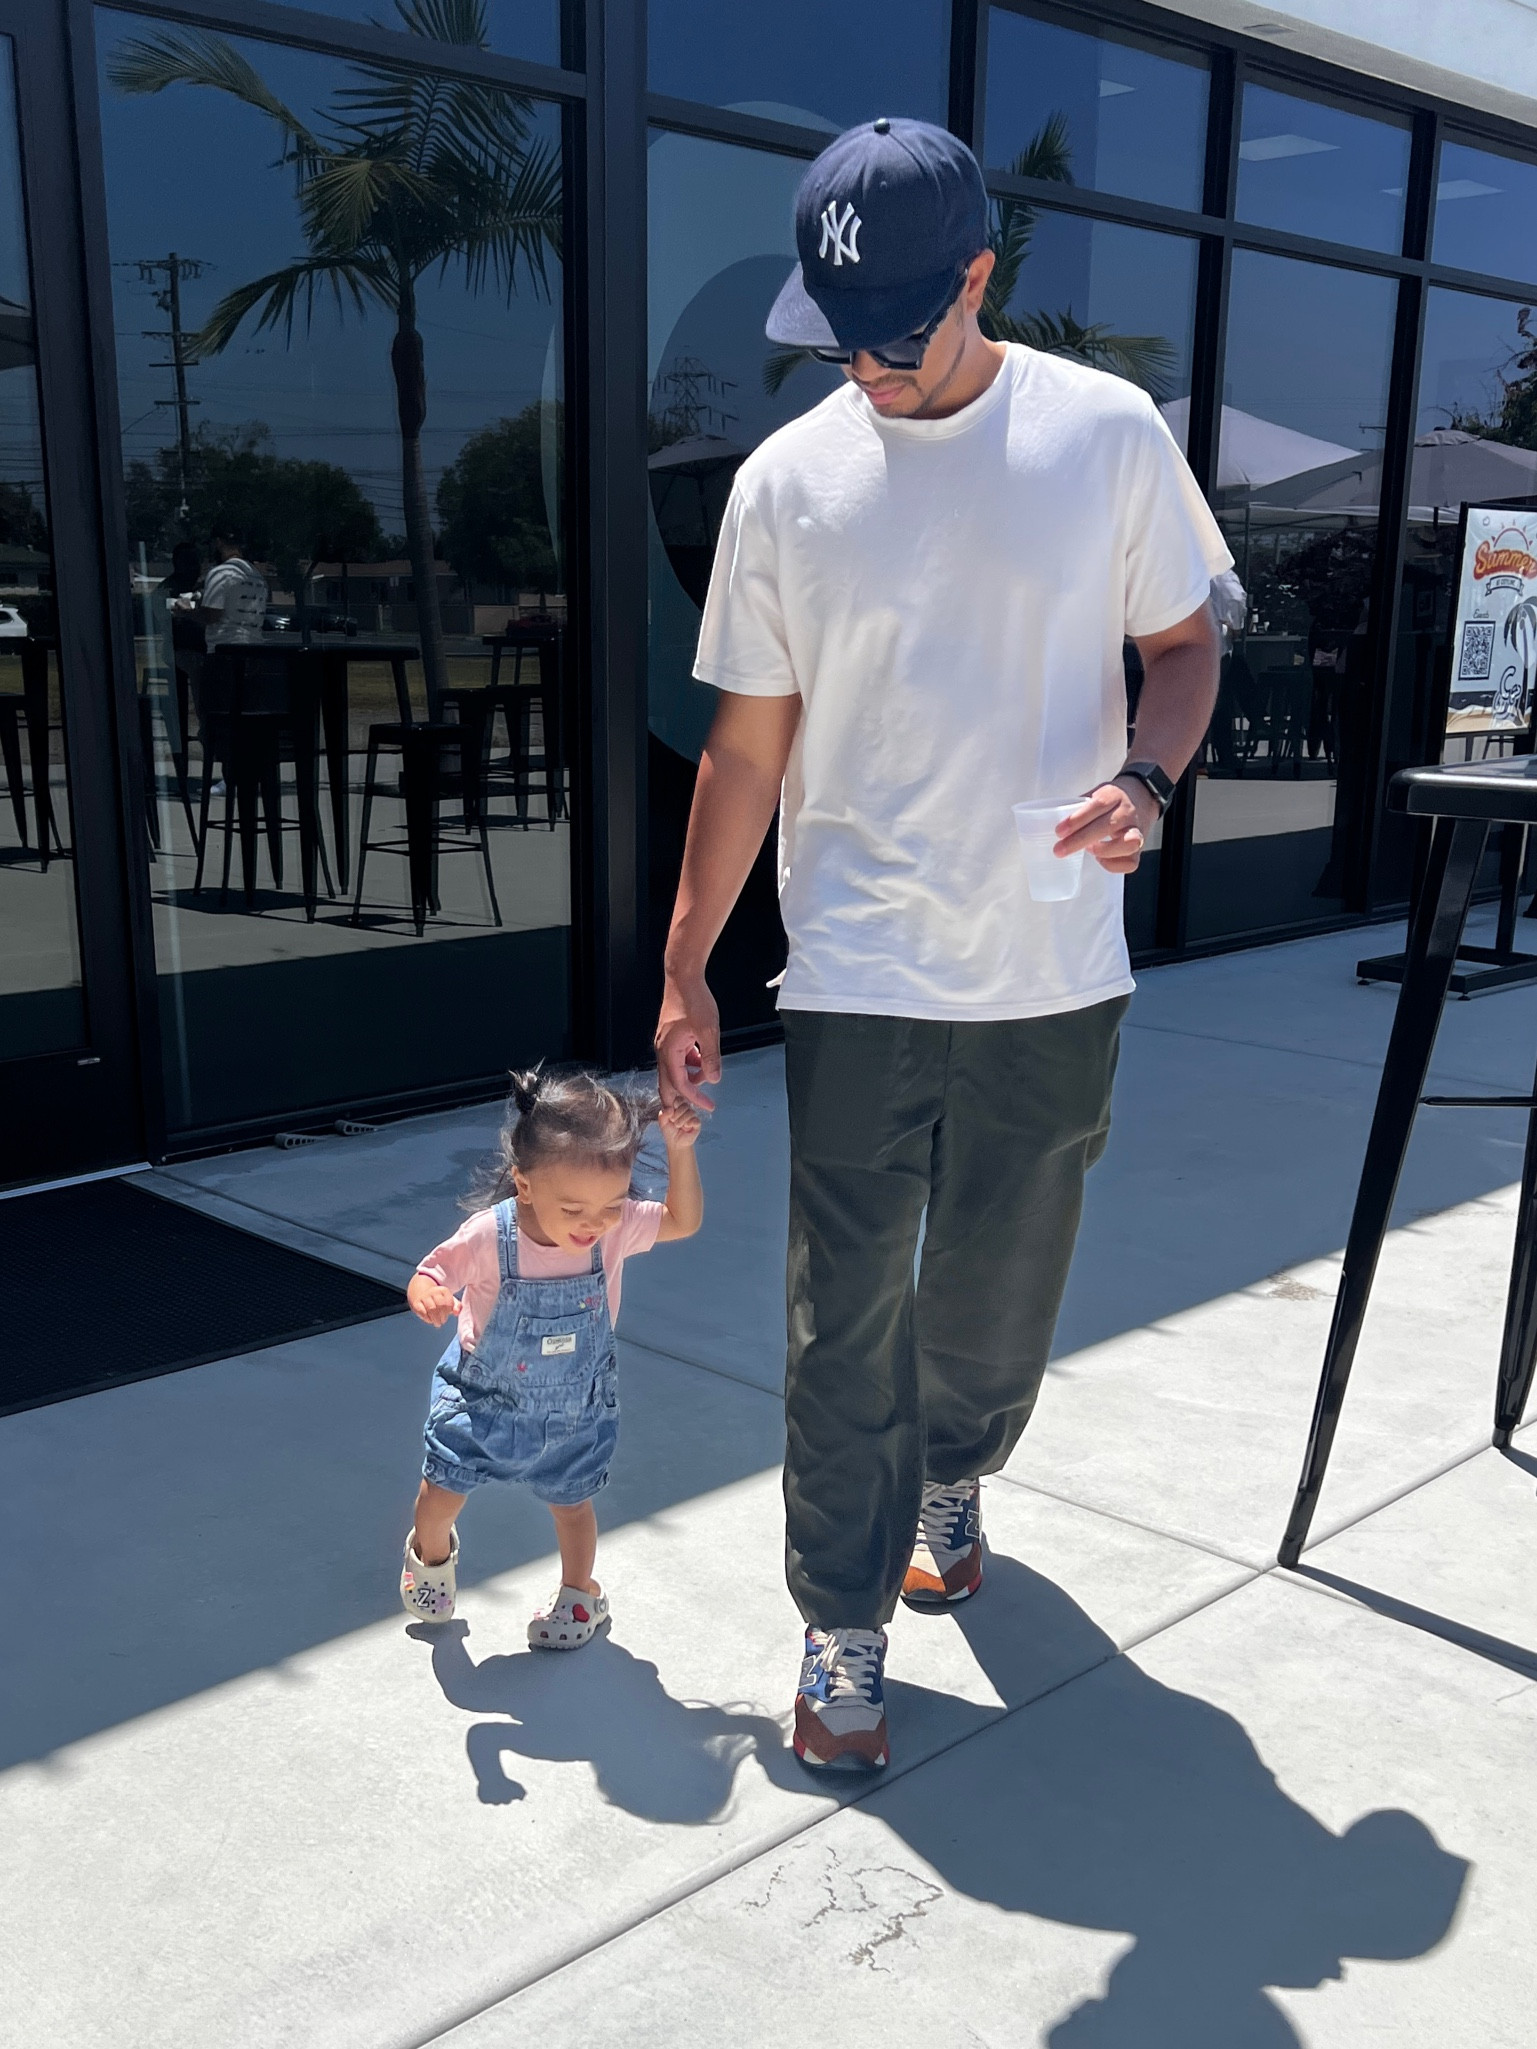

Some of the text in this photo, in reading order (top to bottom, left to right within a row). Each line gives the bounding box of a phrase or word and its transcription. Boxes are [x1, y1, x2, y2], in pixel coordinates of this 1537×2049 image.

[819, 200, 862, 266] NY
[1475, 543, 1537, 577] Summer
[417, 1587, 431, 1608] Z
